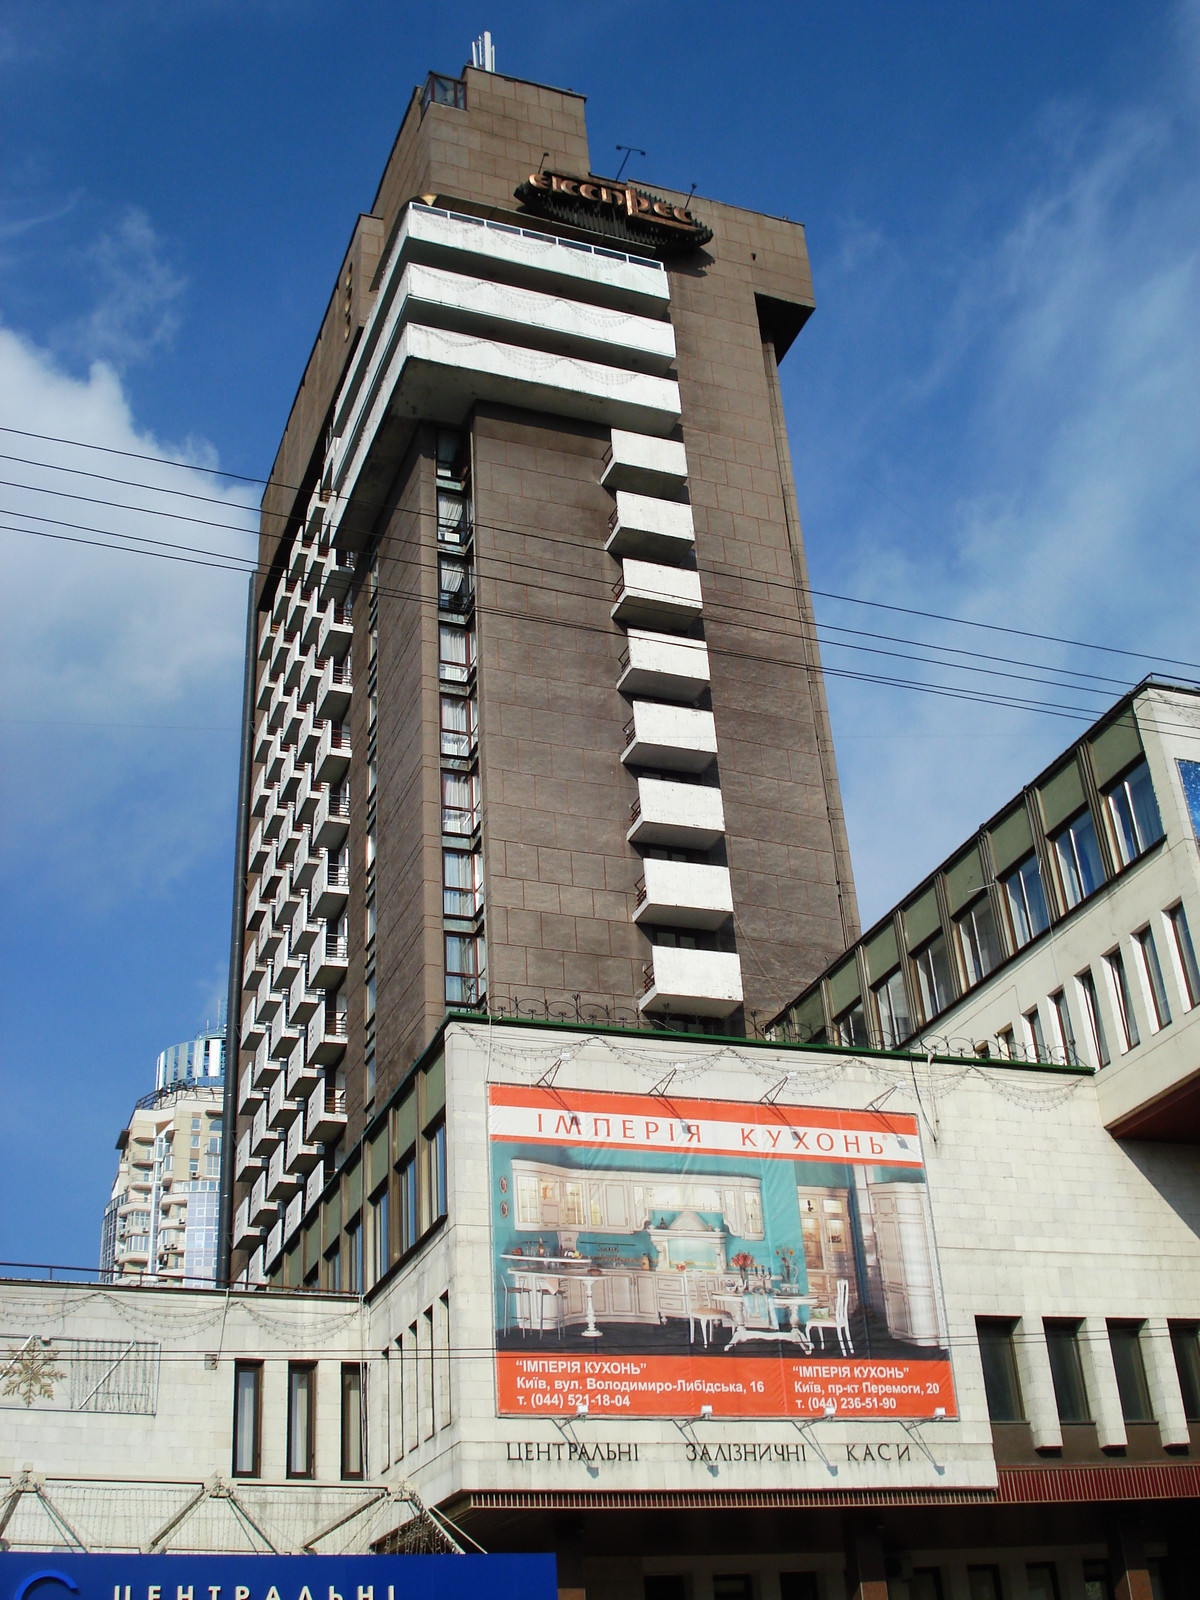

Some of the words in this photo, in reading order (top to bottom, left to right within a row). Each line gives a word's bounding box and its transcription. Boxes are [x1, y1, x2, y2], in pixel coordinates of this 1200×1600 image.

[537, 1113, 701, 1143] ІМПЕРІЯ
[516, 1376, 550, 1391] Київ,
[554, 1379, 583, 1394] вул.
[586, 1377, 747, 1395] Володимиро-Либідська,
[750, 1381, 765, 1393] 16
[794, 1381, 825, 1395] Київ,
[828, 1384, 859, 1398] пр-кт
[862, 1382, 924, 1398] Перемоги,
[926, 1383, 940, 1394] 20
[517, 1395, 527, 1406] т.
[530, 1394, 564, 1409] (044)
[567, 1393, 631, 1407] 521-18-04
[795, 1399, 805, 1409] т.
[808, 1398, 838, 1411] (044)
[840, 1397, 897, 1410] 236-51-90
[506, 1443, 640, 1462] ЦЕНТРАЛЬНІ
[685, 1443, 807, 1462] ЗАЛІЗНИЧНІ
[846, 1444, 911, 1462] КАСИ
